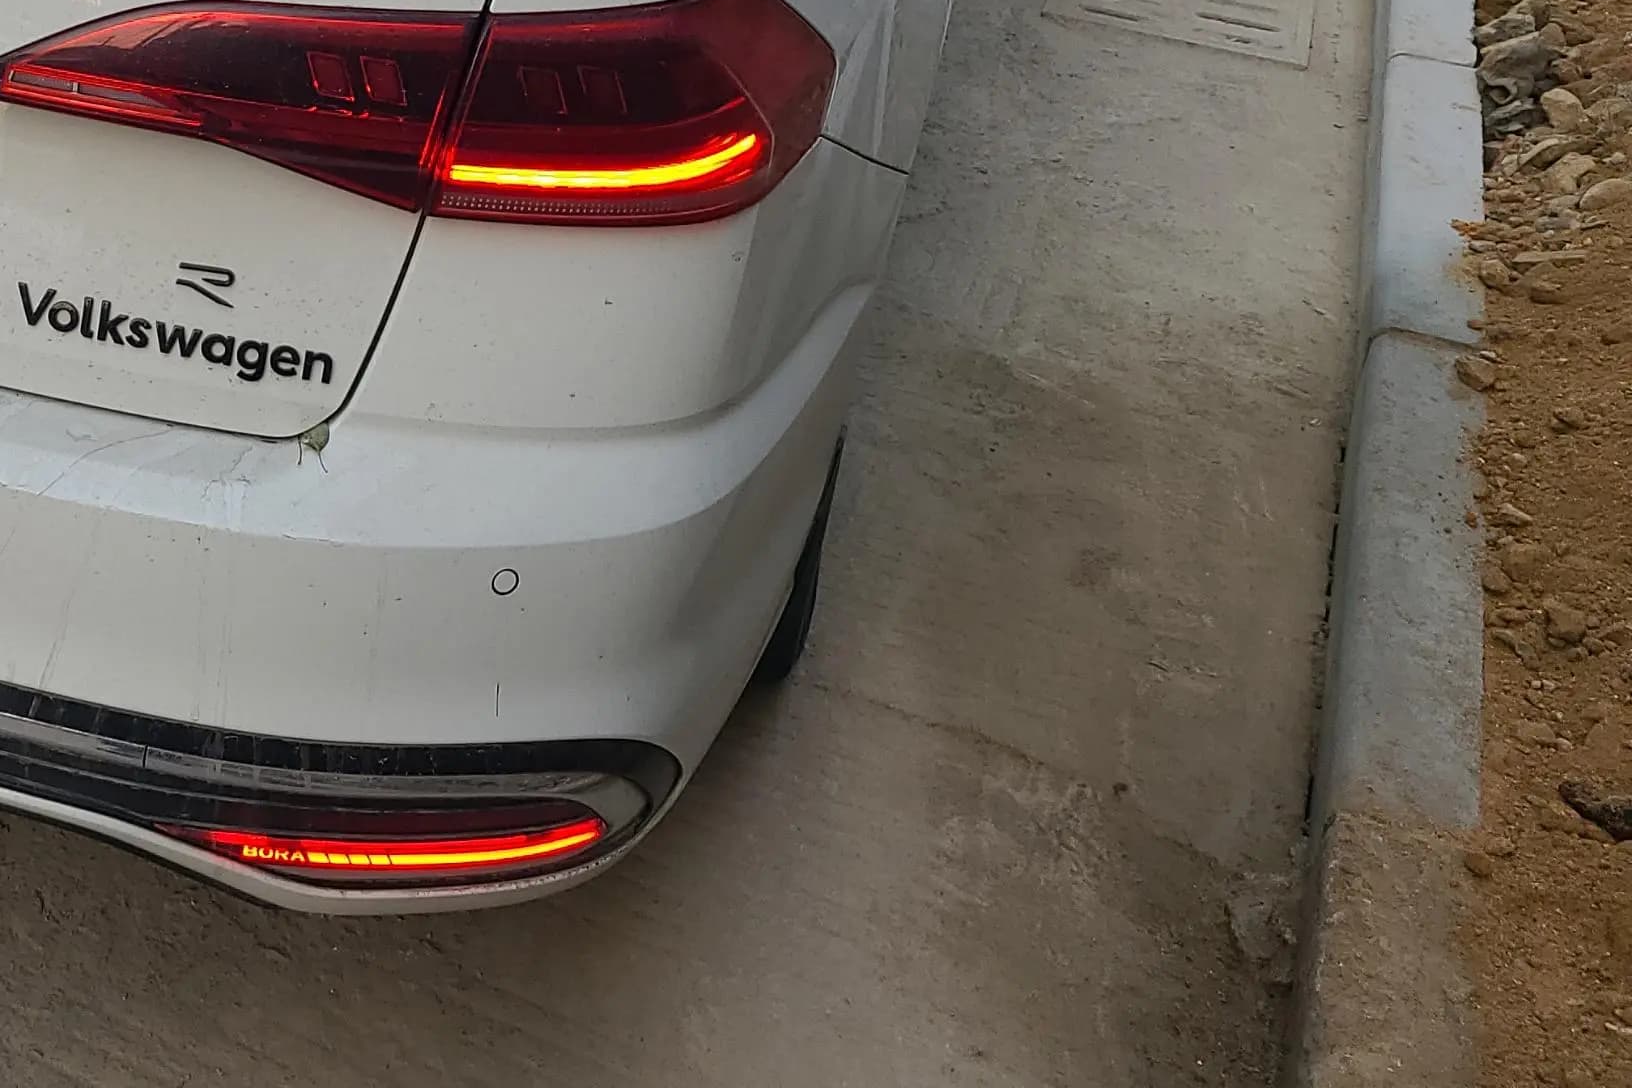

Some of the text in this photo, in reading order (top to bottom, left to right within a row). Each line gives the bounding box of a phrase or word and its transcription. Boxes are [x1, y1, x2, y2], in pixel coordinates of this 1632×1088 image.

[176, 262, 235, 308] R
[18, 281, 333, 384] Volkswagen
[243, 845, 305, 862] BORA
